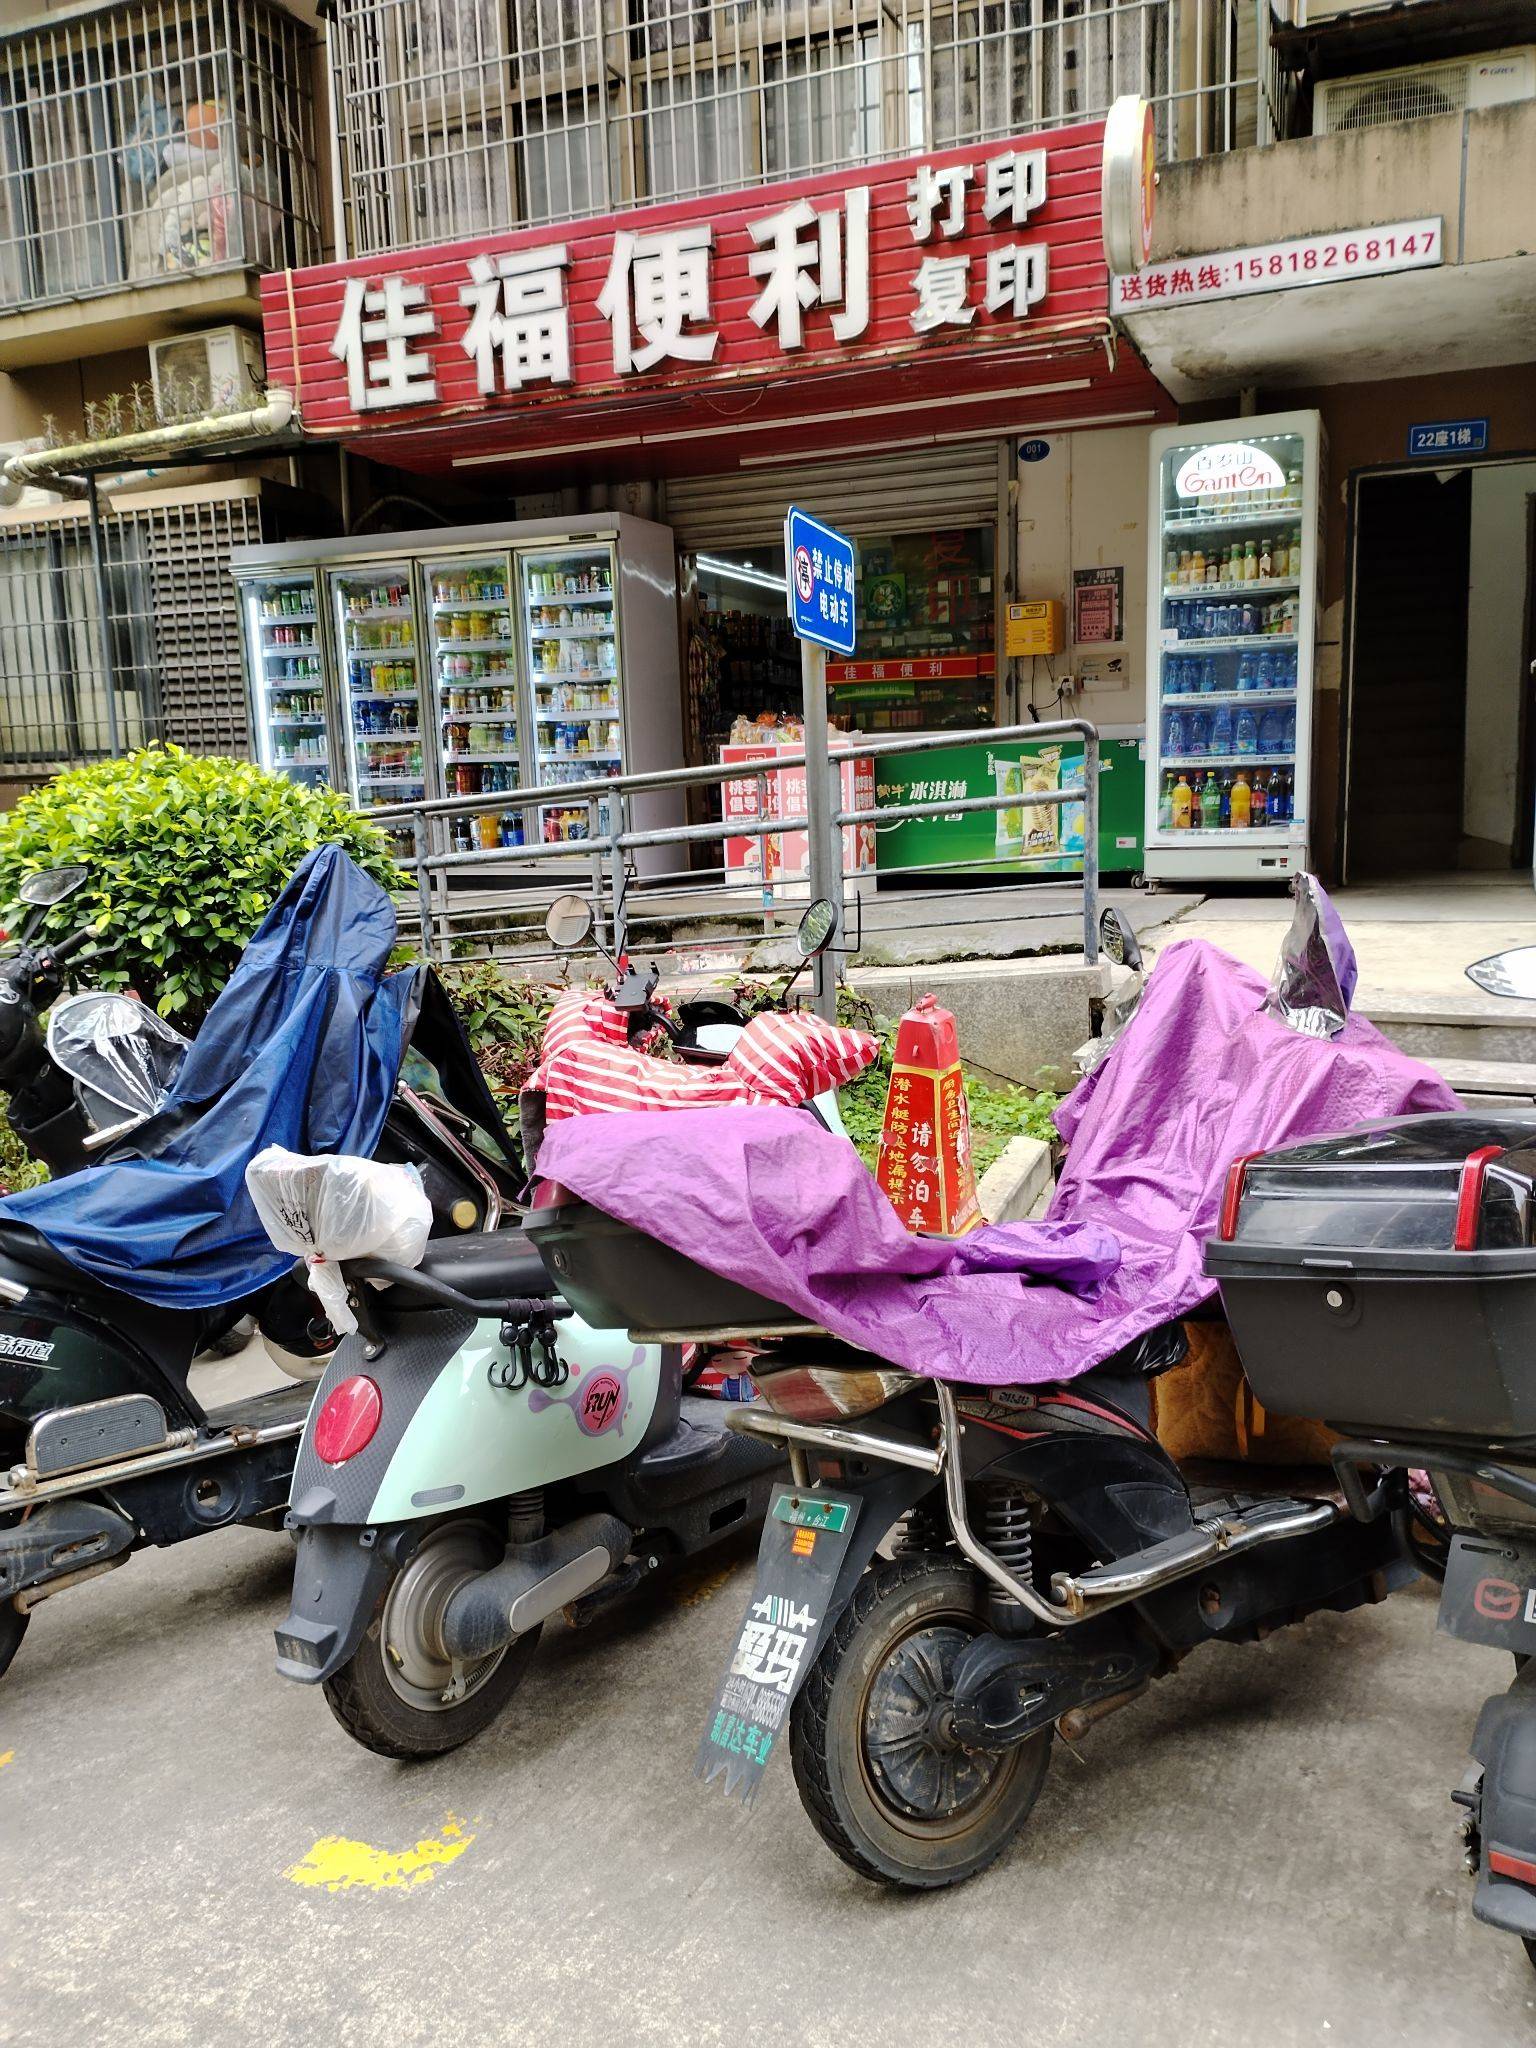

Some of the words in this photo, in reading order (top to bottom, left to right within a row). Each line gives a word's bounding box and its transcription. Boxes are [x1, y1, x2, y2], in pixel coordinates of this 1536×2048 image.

[907, 149, 1048, 241] 打印
[907, 243, 1049, 335] 复印
[1120, 232, 1437, 303] 送货热线:15818268147
[329, 185, 871, 413] 佳福便利
[1026, 443, 1042, 455] 001
[1416, 428, 1472, 449] 22座1梯
[812, 547, 853, 595] 禁止停放
[819, 588, 849, 629] 电动车
[844, 661, 943, 680] 佳福便利
[877, 783, 905, 799] 蒙牛
[909, 780, 968, 801] 冰淇淋
[907, 1121, 933, 1230] 请勿泊车
